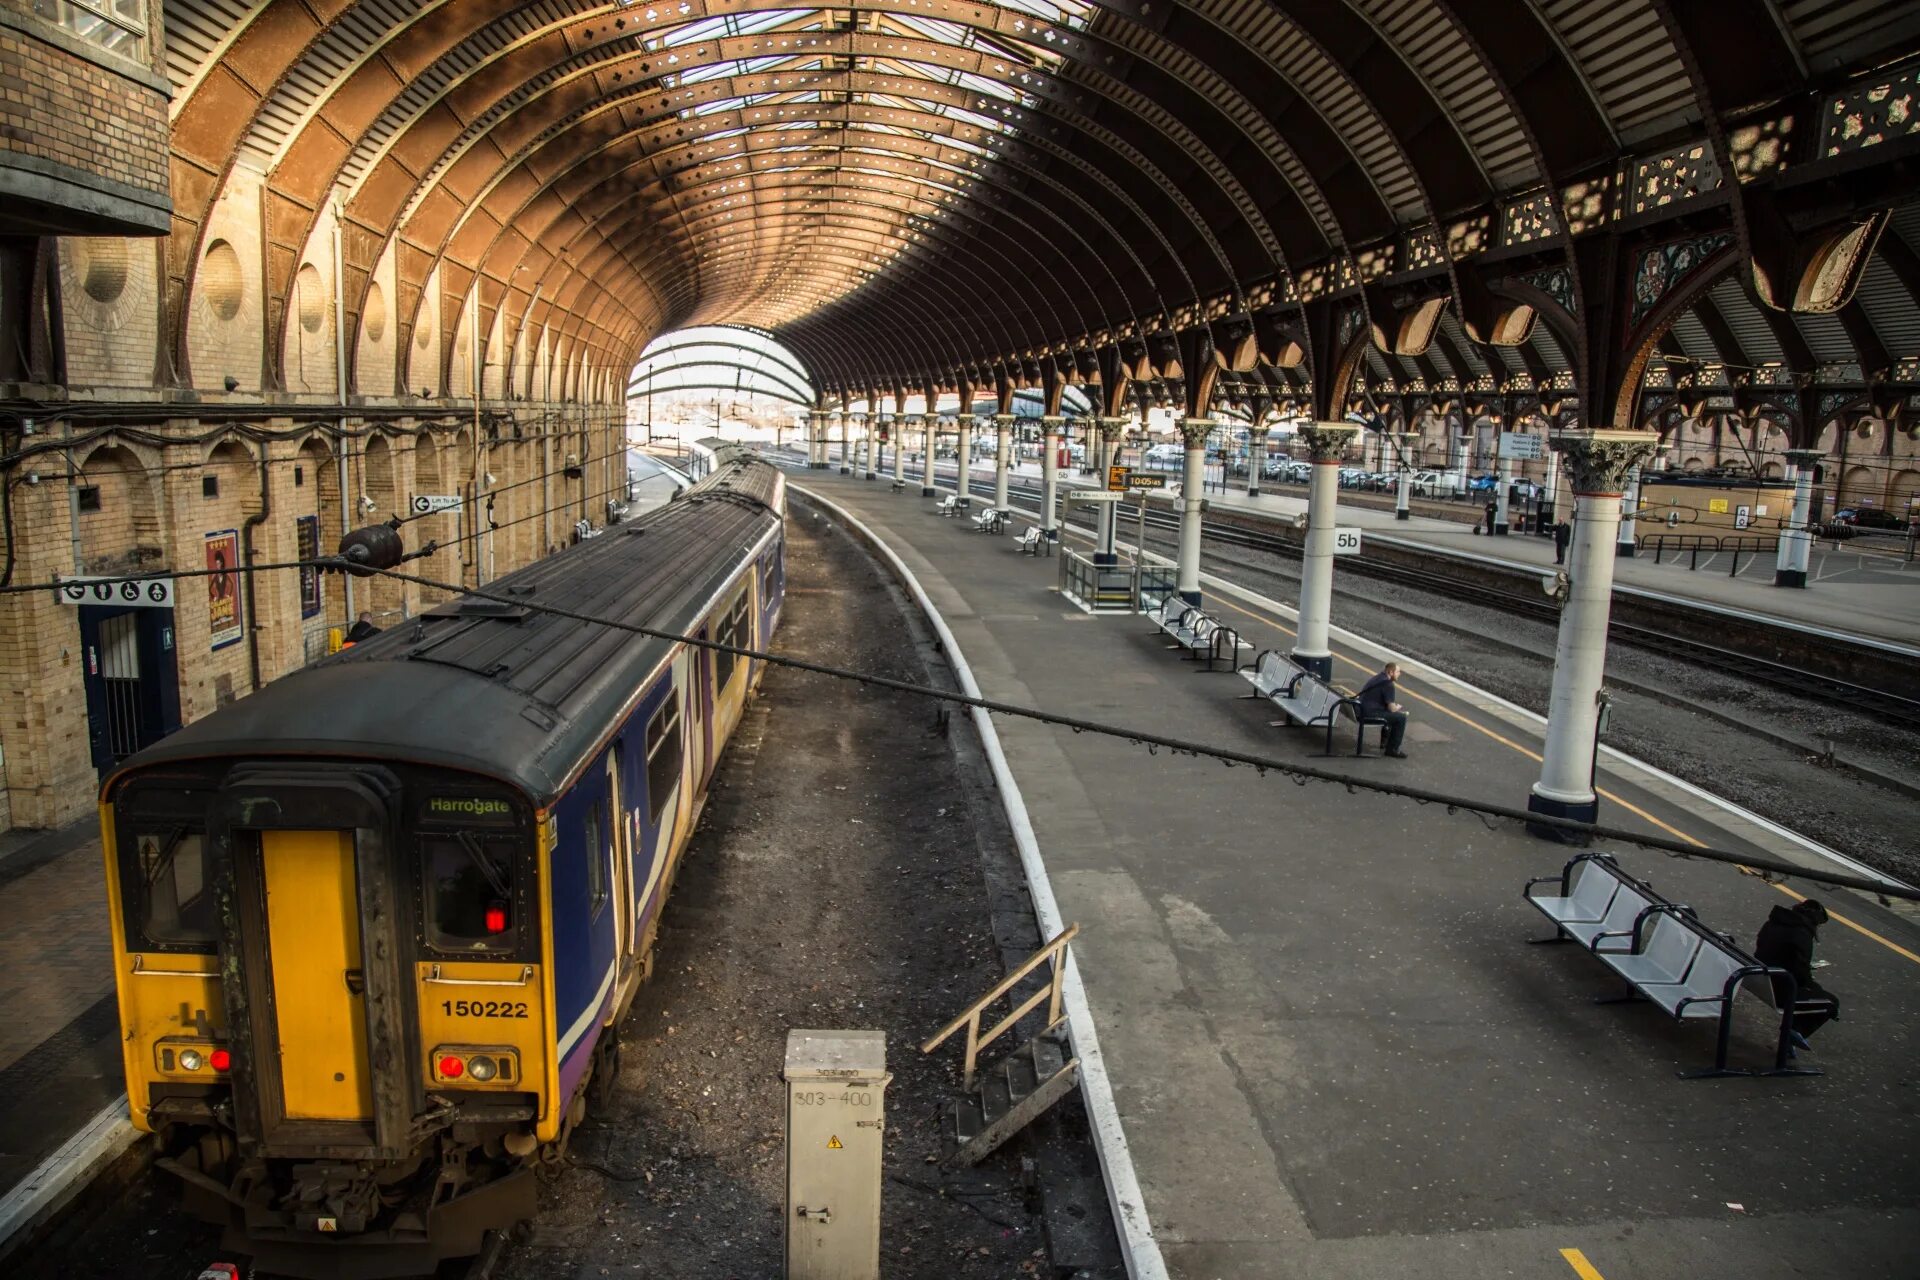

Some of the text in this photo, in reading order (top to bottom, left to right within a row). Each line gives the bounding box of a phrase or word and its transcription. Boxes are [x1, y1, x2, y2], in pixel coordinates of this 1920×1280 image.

[1058, 471, 1068, 479] 5b
[1337, 533, 1357, 548] 5b
[431, 797, 511, 815] Harrogate
[442, 1000, 529, 1019] 150222
